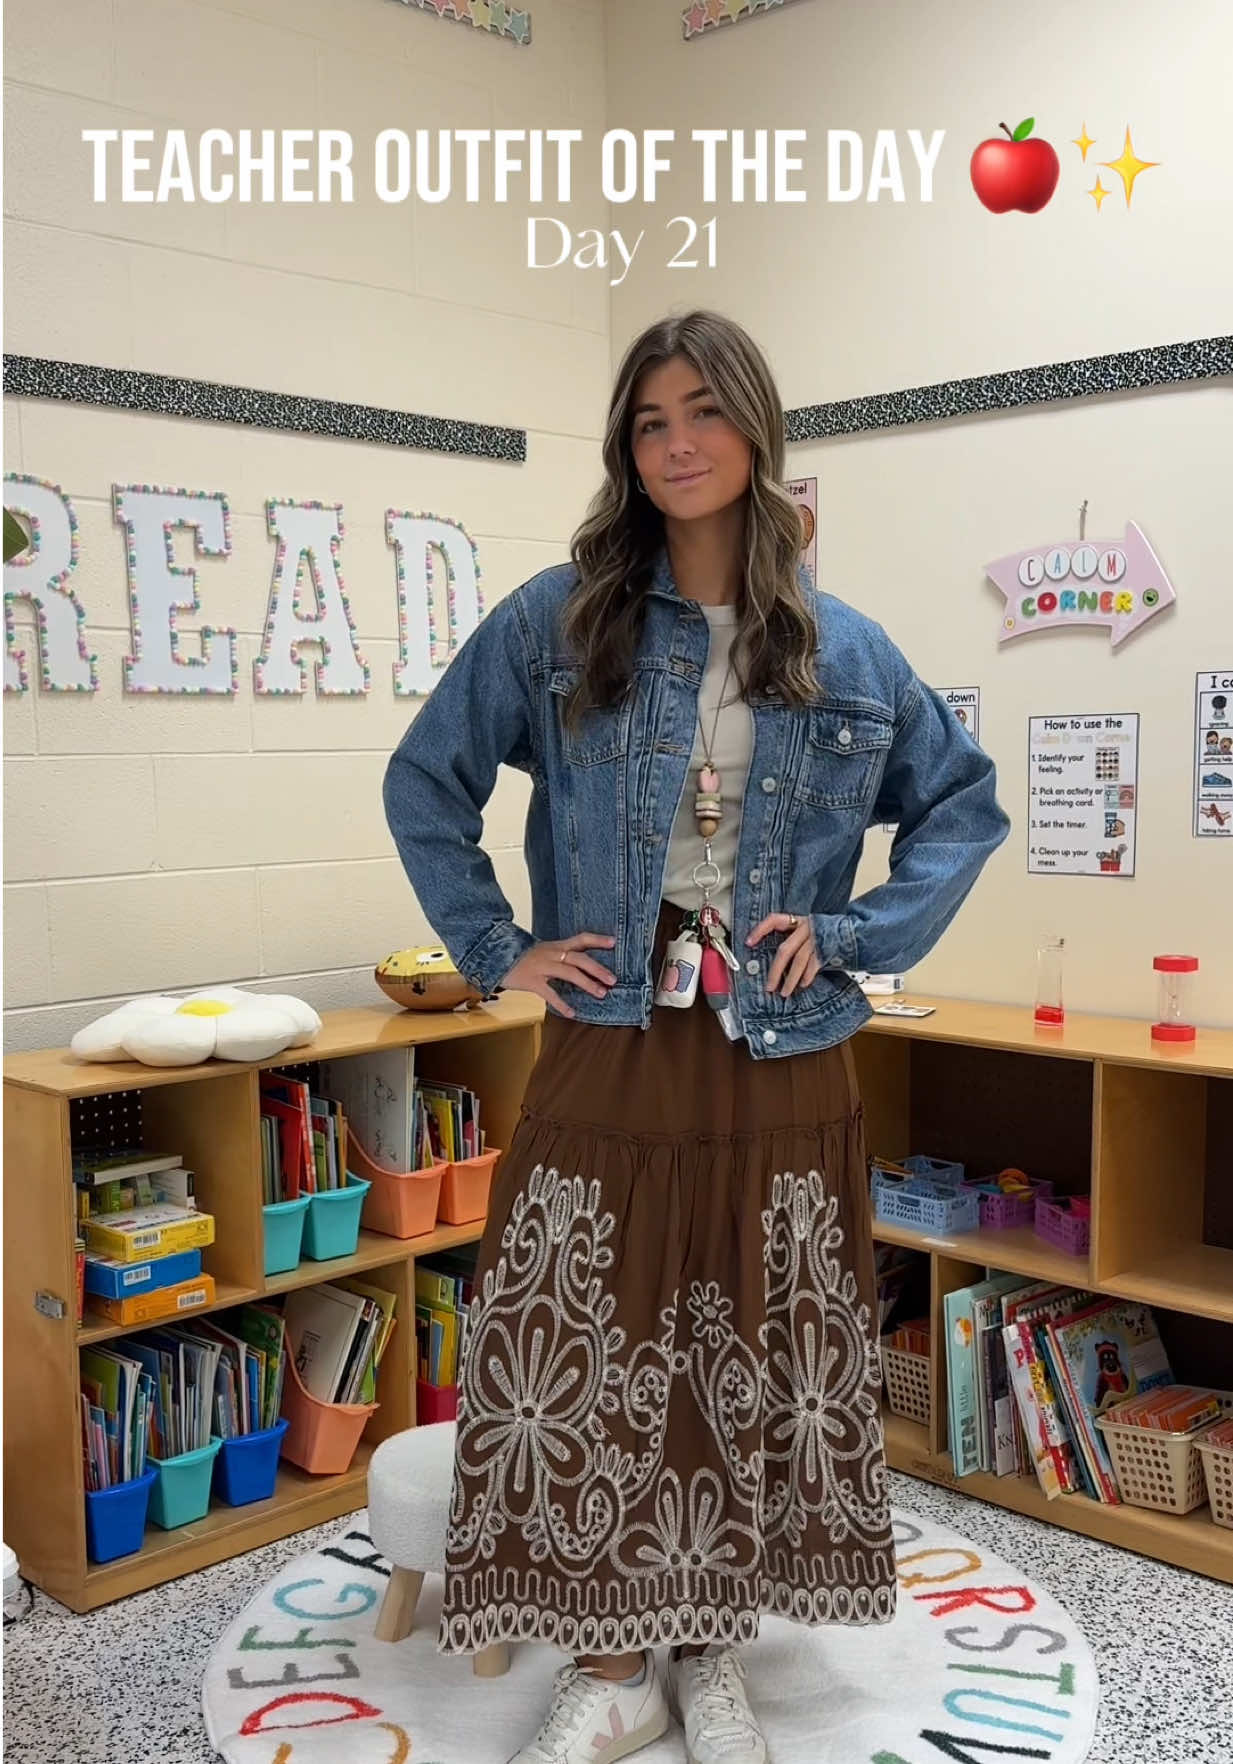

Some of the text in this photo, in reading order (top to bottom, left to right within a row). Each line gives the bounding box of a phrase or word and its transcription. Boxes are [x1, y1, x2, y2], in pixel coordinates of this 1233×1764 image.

[3, 472, 487, 697] READ
[1020, 589, 1133, 618] CORNER
[1210, 675, 1218, 689] I
[946, 690, 975, 703] down
[1044, 717, 1122, 730] How to use the
[1038, 753, 1067, 763] Identify
[1068, 754, 1085, 763] your
[1039, 786, 1054, 795] Pick
[1066, 787, 1093, 796] activity
[1039, 798, 1074, 808] breathing
[1039, 820, 1052, 828] Set
[1053, 820, 1065, 828] the
[1038, 846, 1060, 856] Clean
[1061, 848, 1071, 857] up
[1072, 848, 1088, 857] your
[961, 1416, 978, 1472] TEN
